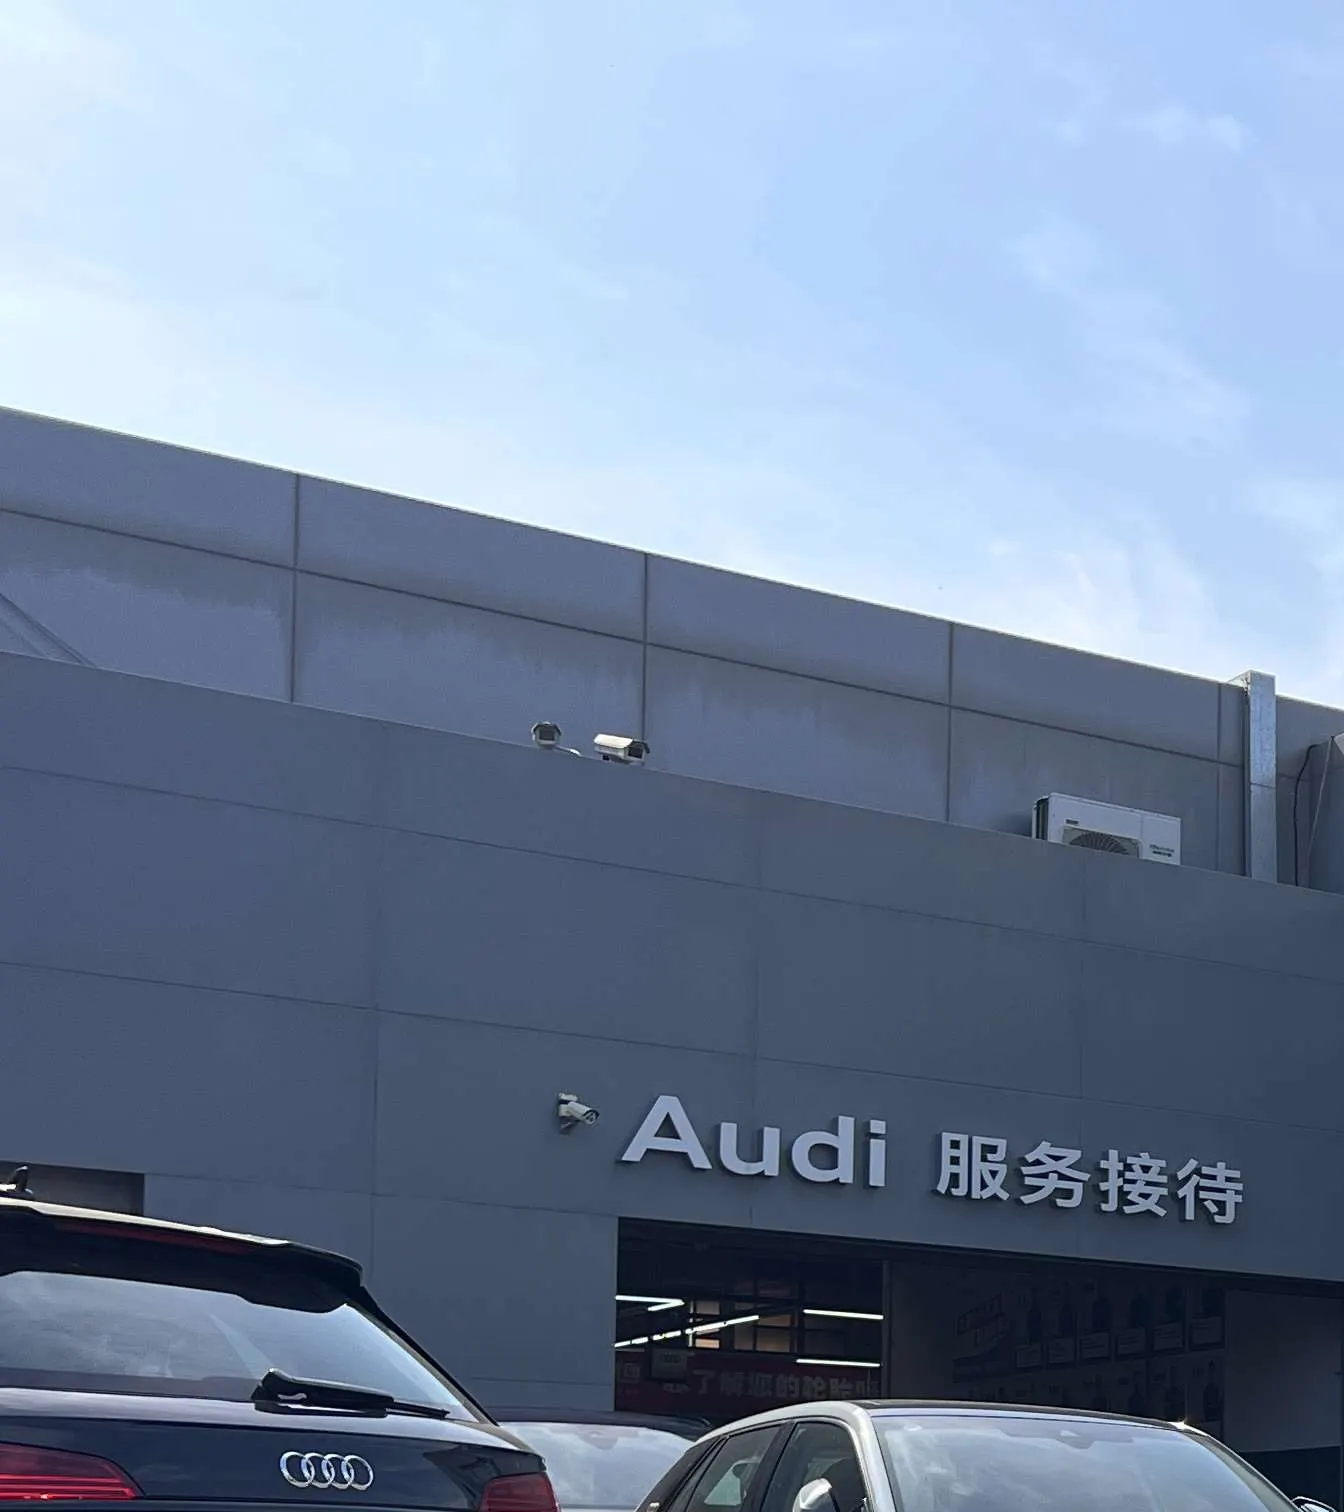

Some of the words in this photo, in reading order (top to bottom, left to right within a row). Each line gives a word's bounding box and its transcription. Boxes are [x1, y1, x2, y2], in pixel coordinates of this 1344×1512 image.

[621, 1095, 887, 1188] Audi
[935, 1131, 1245, 1225] 服务接待
